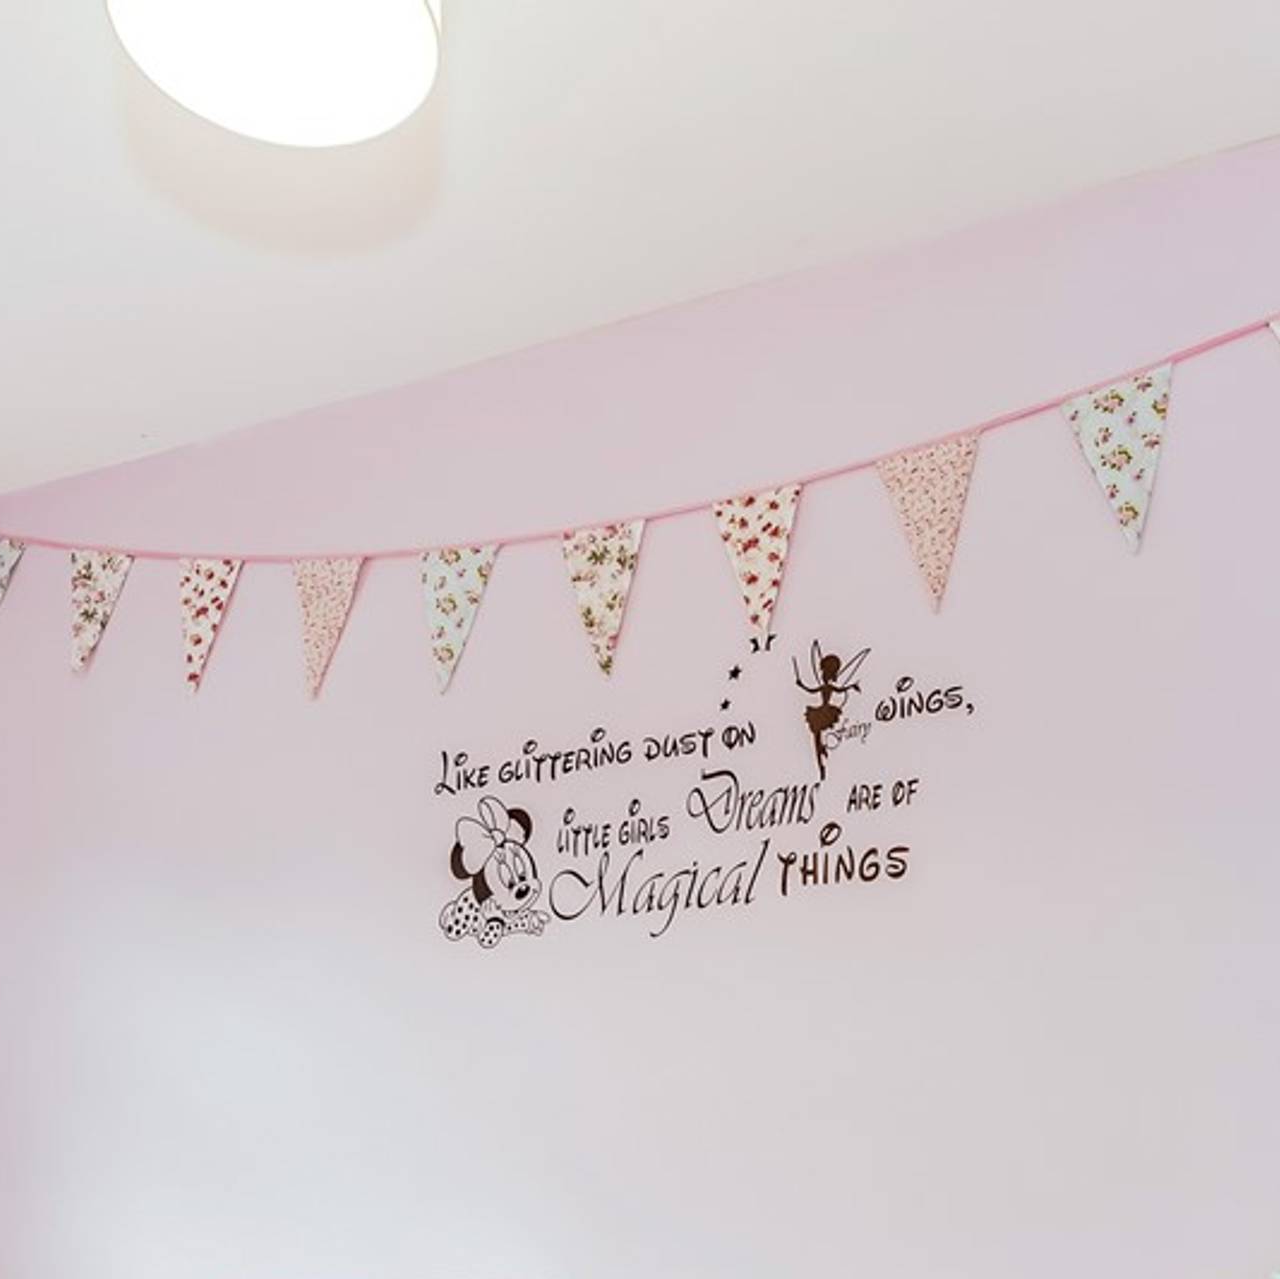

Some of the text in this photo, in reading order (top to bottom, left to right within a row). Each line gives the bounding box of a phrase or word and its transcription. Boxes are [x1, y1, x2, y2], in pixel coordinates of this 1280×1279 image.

[643, 727, 716, 762] DUST
[721, 721, 757, 750] ON
[686, 769, 822, 835] Dreams
[847, 784, 883, 814] ARE
[891, 778, 920, 807] OF
[548, 837, 771, 939] Magical
